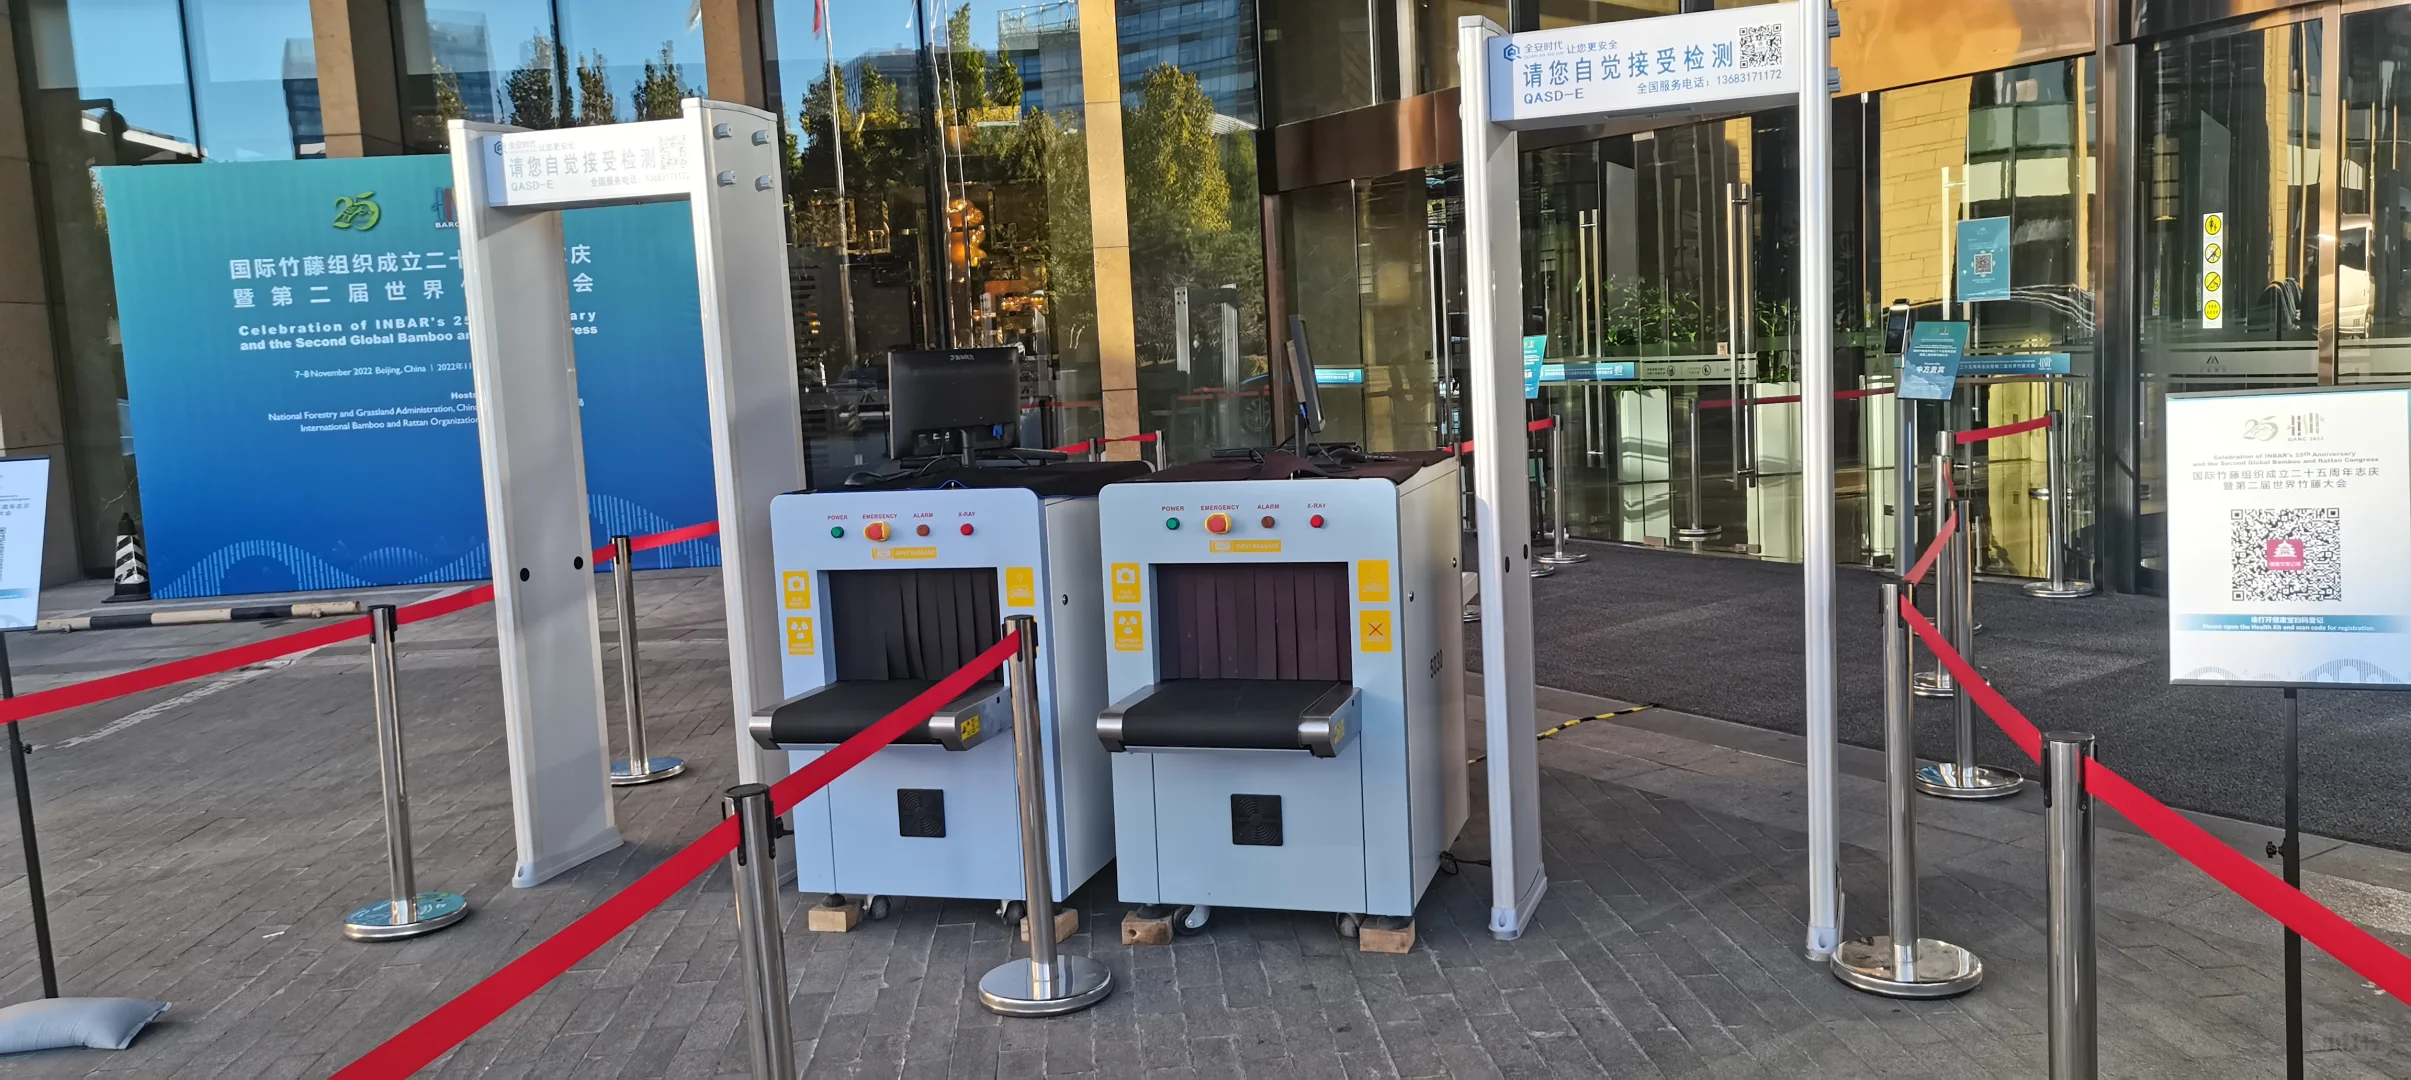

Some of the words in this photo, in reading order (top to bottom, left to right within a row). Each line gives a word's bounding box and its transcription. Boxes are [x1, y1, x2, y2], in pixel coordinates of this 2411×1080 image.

[1523, 40, 1564, 54] 全安时代
[1566, 40, 1618, 54] 让您更安全
[1522, 40, 1734, 88] 请您自觉接受检测
[1523, 87, 1585, 105] QASD-E
[508, 146, 657, 179] 请您自觉接受检测
[511, 180, 554, 192] QASD-E
[238, 322, 343, 337] Celebration
[350, 319, 368, 331] of
[375, 317, 447, 330] INBAR's
[240, 340, 266, 351] and
[269, 339, 293, 350] the
[295, 336, 347, 348] Second
[350, 333, 395, 346] Global
[398, 331, 453, 344] Bamboo
[310, 369, 352, 378] November
[353, 367, 373, 376] 2022
[375, 365, 403, 376] Beijing,
[403, 364, 427, 374] China
[268, 411, 303, 422] National
[304, 410, 338, 420] Forestry
[340, 408, 354, 418] and
[356, 406, 395, 417] Grassland
[396, 405, 455, 416] Administration,
[300, 421, 350, 432] International
[352, 420, 385, 430] Bamboo
[386, 419, 402, 428] and
[403, 417, 429, 427] Rattan
[2312, 451, 2356, 459] Anniversary
[2192, 466, 2380, 480] 国际竹藤组织成立二十五周年志庆
[2223, 478, 2348, 490] 暨第二届世界竹藤大会
